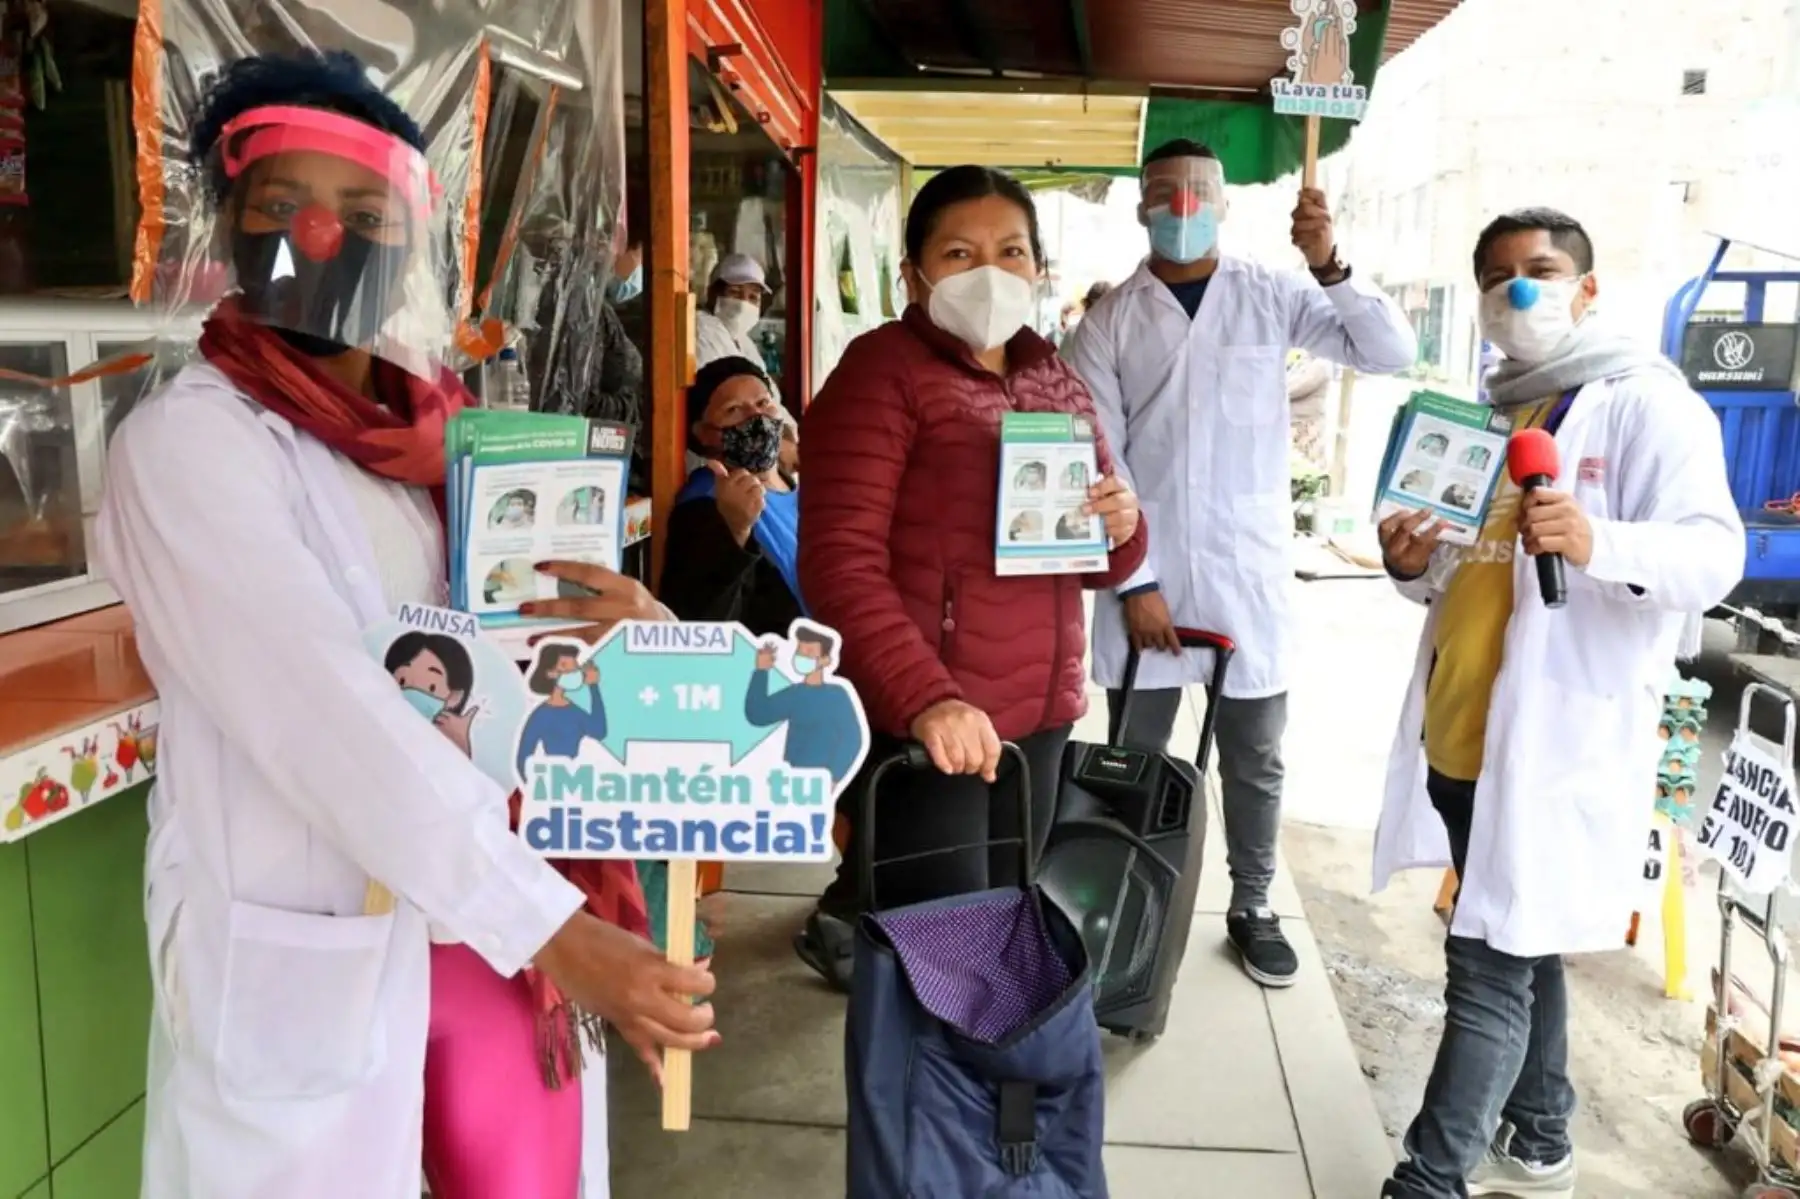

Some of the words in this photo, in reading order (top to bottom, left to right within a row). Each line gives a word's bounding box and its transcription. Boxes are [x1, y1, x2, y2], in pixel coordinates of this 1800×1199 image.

[1273, 80, 1326, 97] ¡Lava
[1333, 85, 1364, 100] tus
[399, 604, 476, 638] MINSA
[632, 624, 728, 648] MINSA
[673, 683, 722, 711] 1M
[533, 761, 752, 804] ¡Mantén
[767, 768, 823, 805] tu
[525, 807, 827, 854] distancia!
